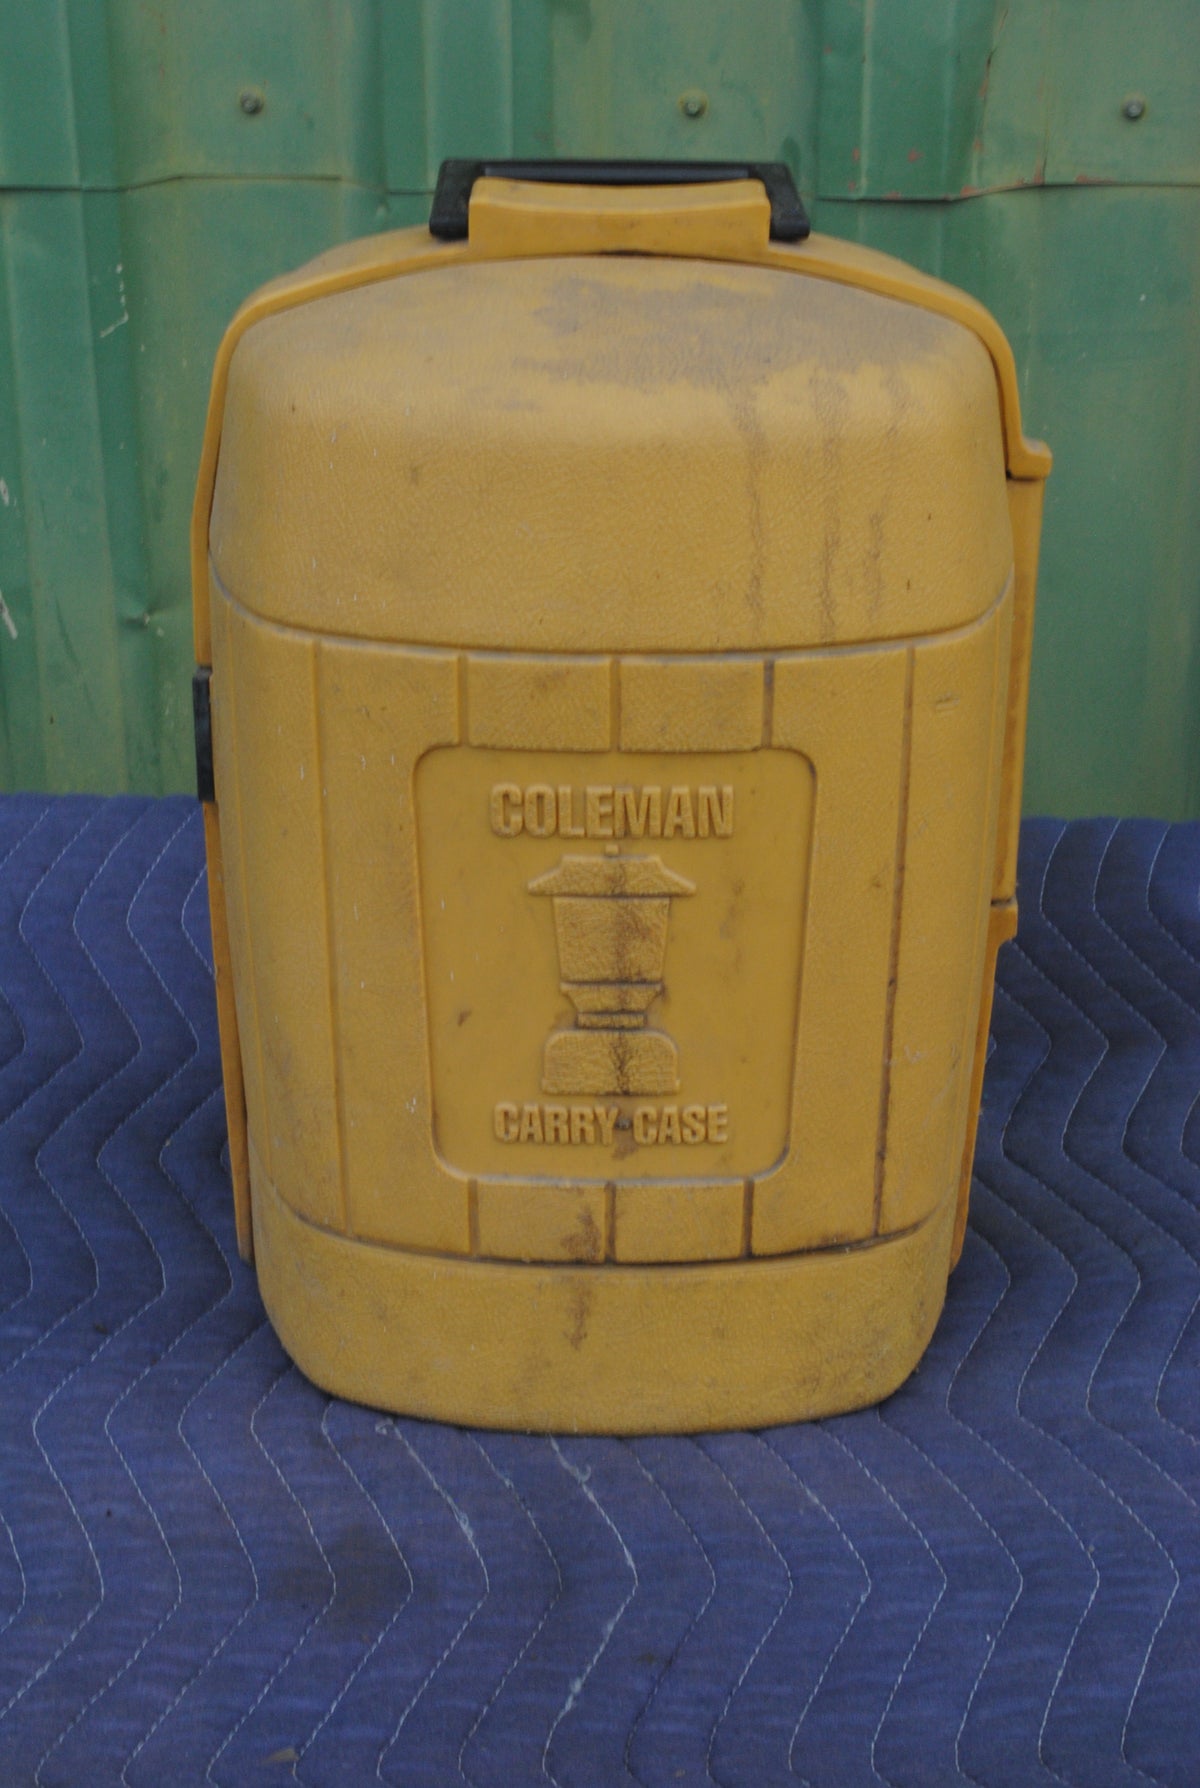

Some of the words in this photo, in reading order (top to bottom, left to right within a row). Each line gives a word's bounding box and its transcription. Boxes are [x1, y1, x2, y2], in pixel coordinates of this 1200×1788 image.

[491, 783, 733, 839] COLEMAN
[494, 1102, 618, 1145] CARRY
[633, 1103, 728, 1145] CASE
